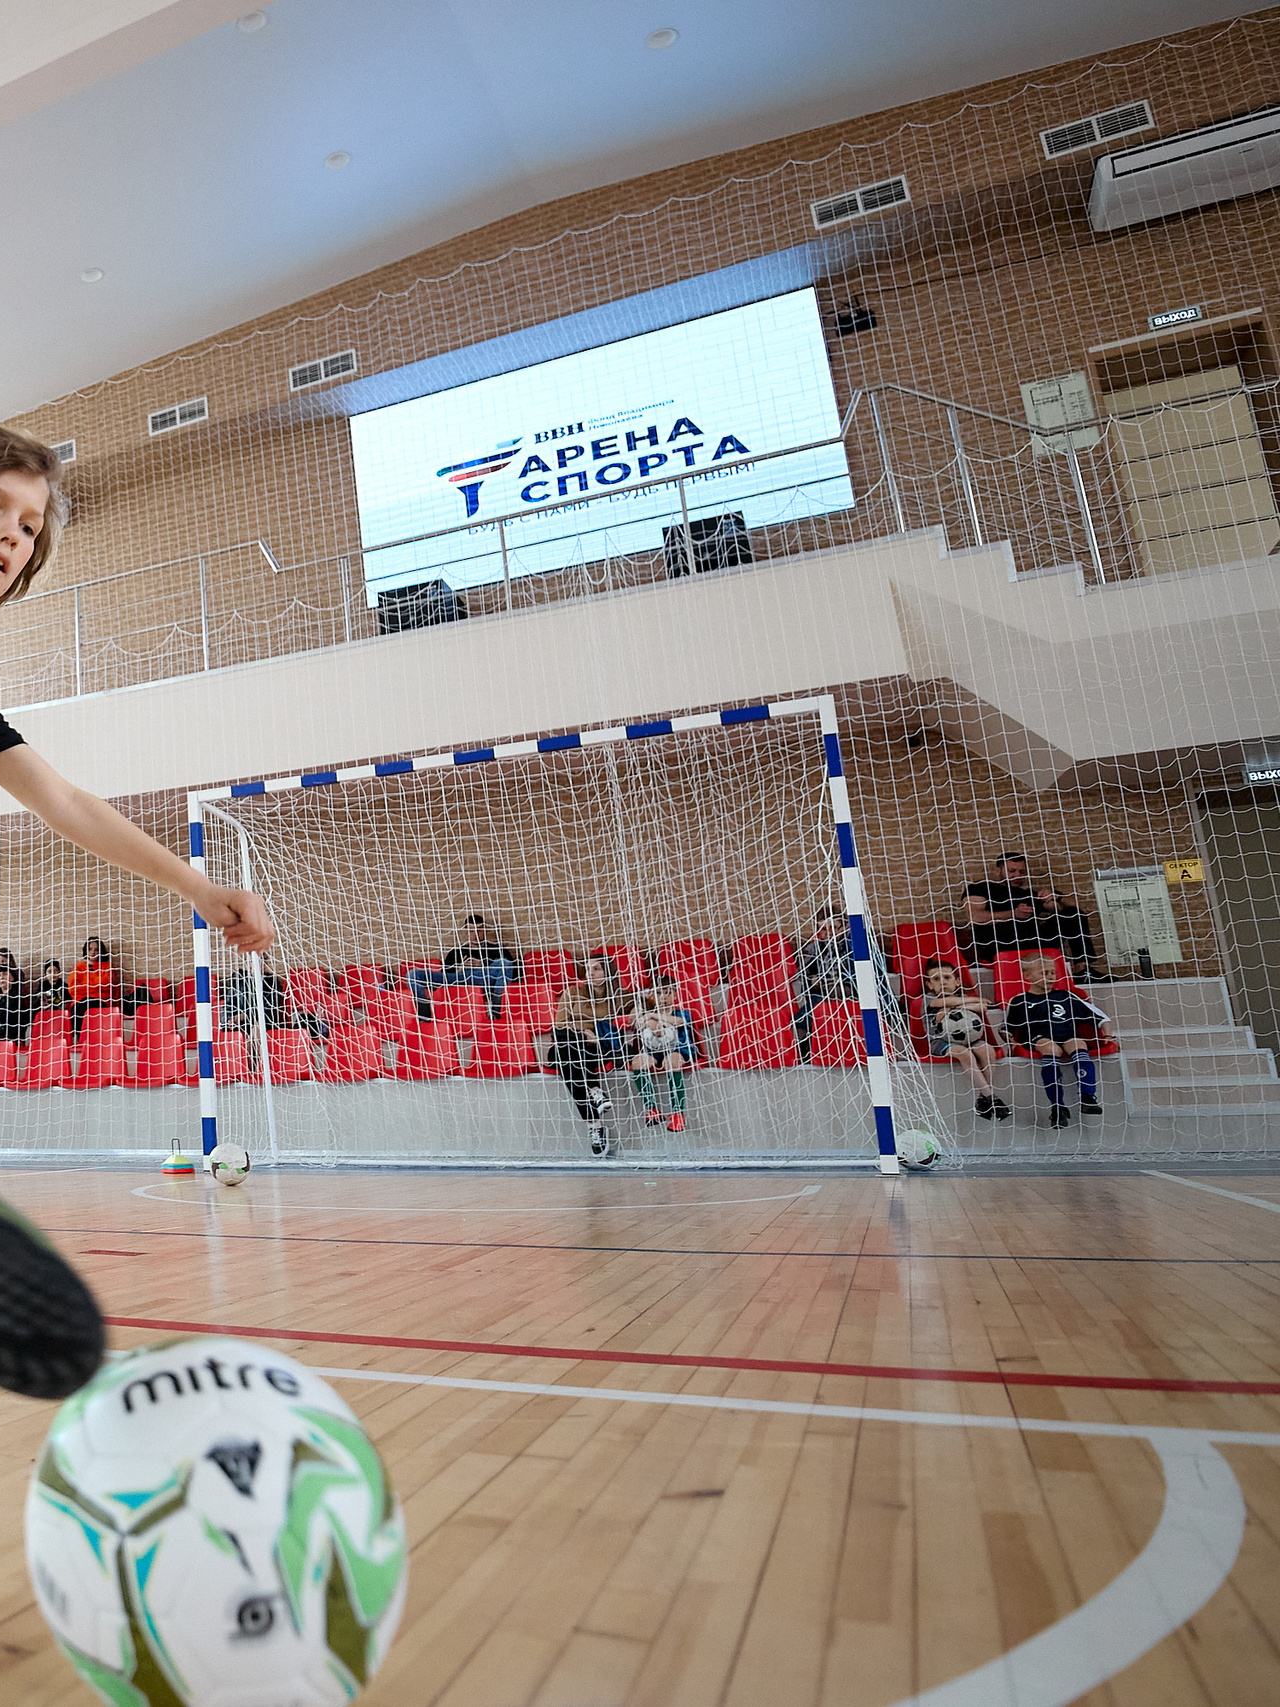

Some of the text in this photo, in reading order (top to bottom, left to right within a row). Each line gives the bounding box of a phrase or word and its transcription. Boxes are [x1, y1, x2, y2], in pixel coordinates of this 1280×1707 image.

[1154, 309, 1196, 326] ВЫХОД
[518, 416, 705, 479] АРЕНА
[534, 422, 586, 444] ВВН
[520, 434, 752, 503] СПОРТА
[1248, 769, 1280, 781] ВЫХ
[121, 1356, 302, 1413] mitre
